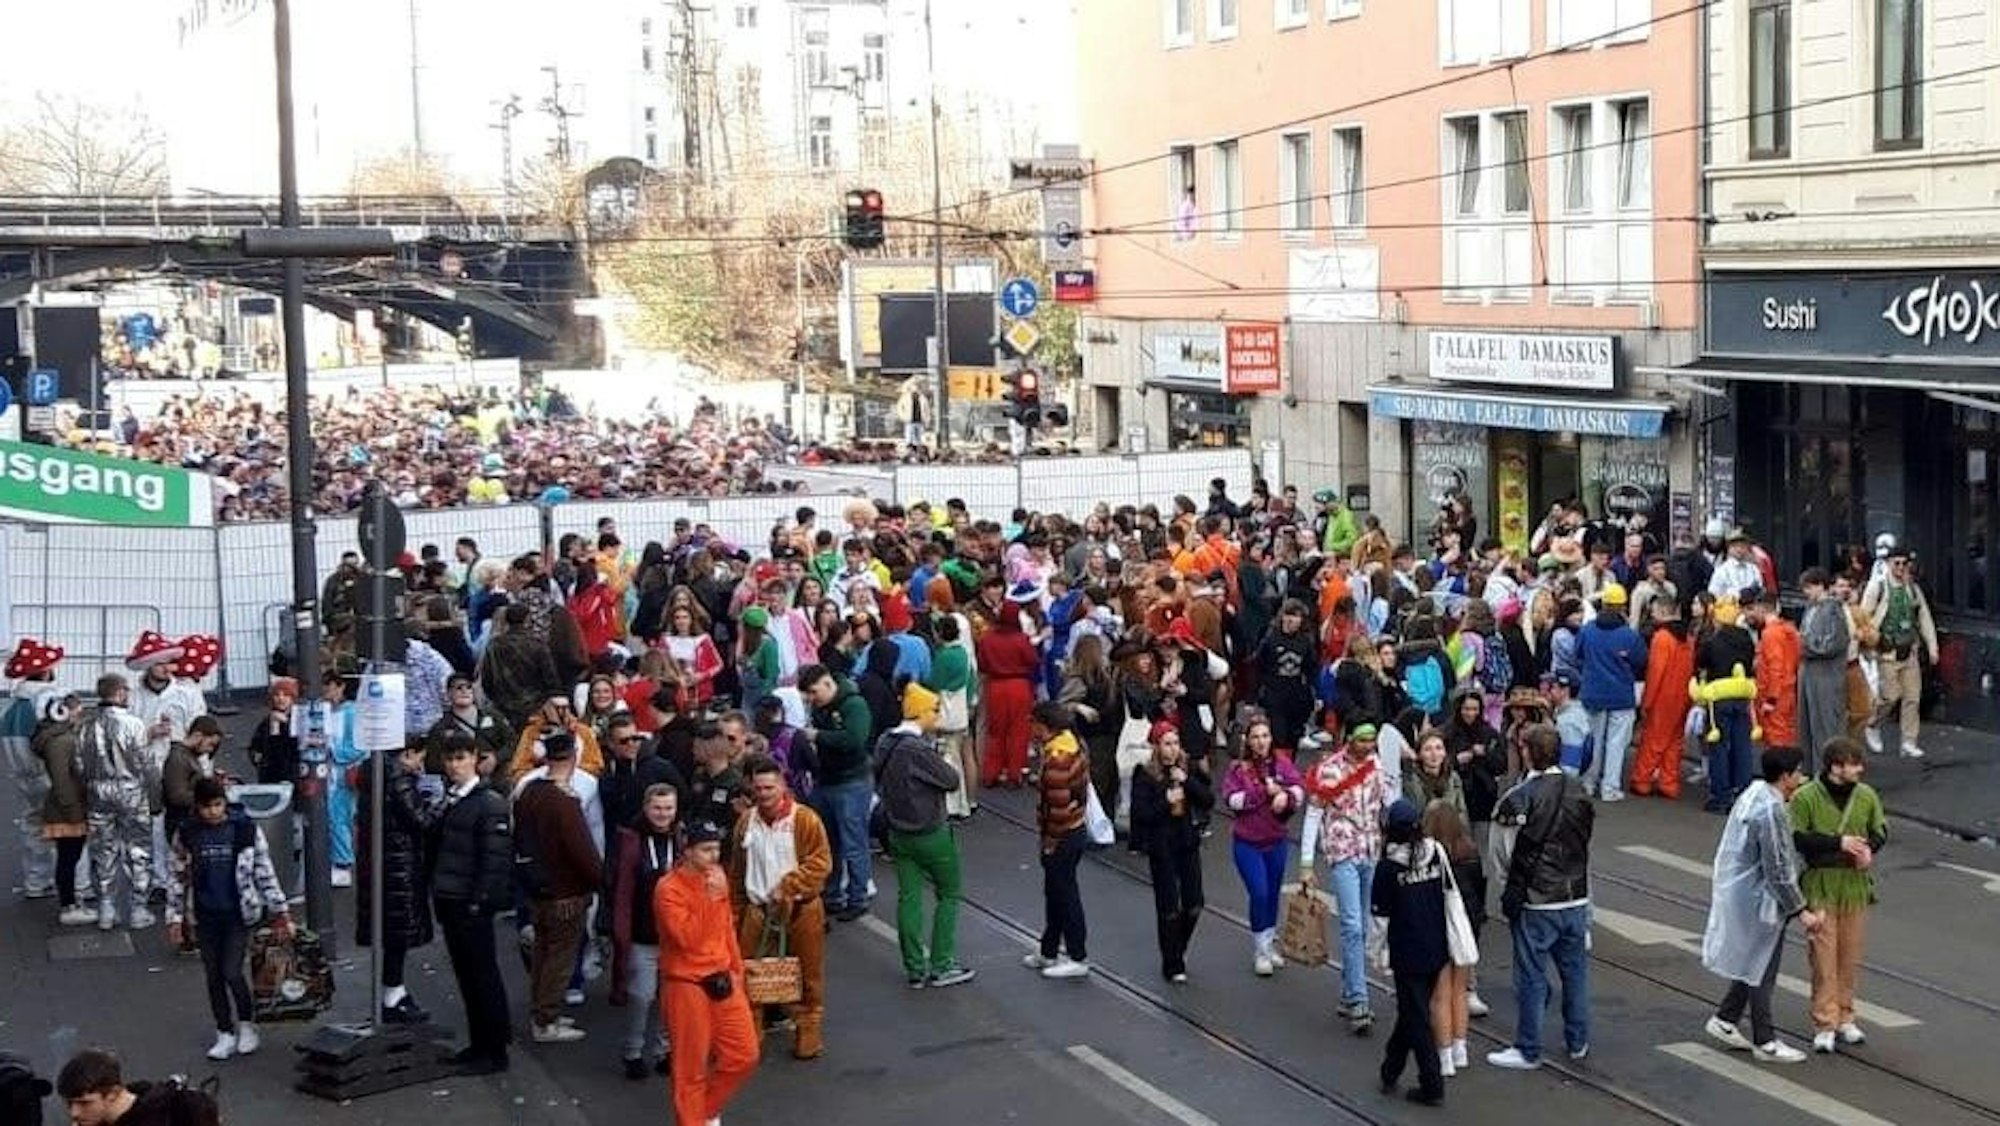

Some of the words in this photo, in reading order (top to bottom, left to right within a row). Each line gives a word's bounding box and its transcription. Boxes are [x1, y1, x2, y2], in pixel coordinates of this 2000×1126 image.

[1763, 297, 1817, 329] Sushi
[1436, 336, 1508, 361] FALAFEL
[1519, 339, 1609, 366] DAMASKUS
[34, 373, 50, 399] P
[1474, 402, 1535, 430] FALAFEL
[1544, 408, 1629, 434] DAMASKUS
[0, 448, 166, 511] sgang
